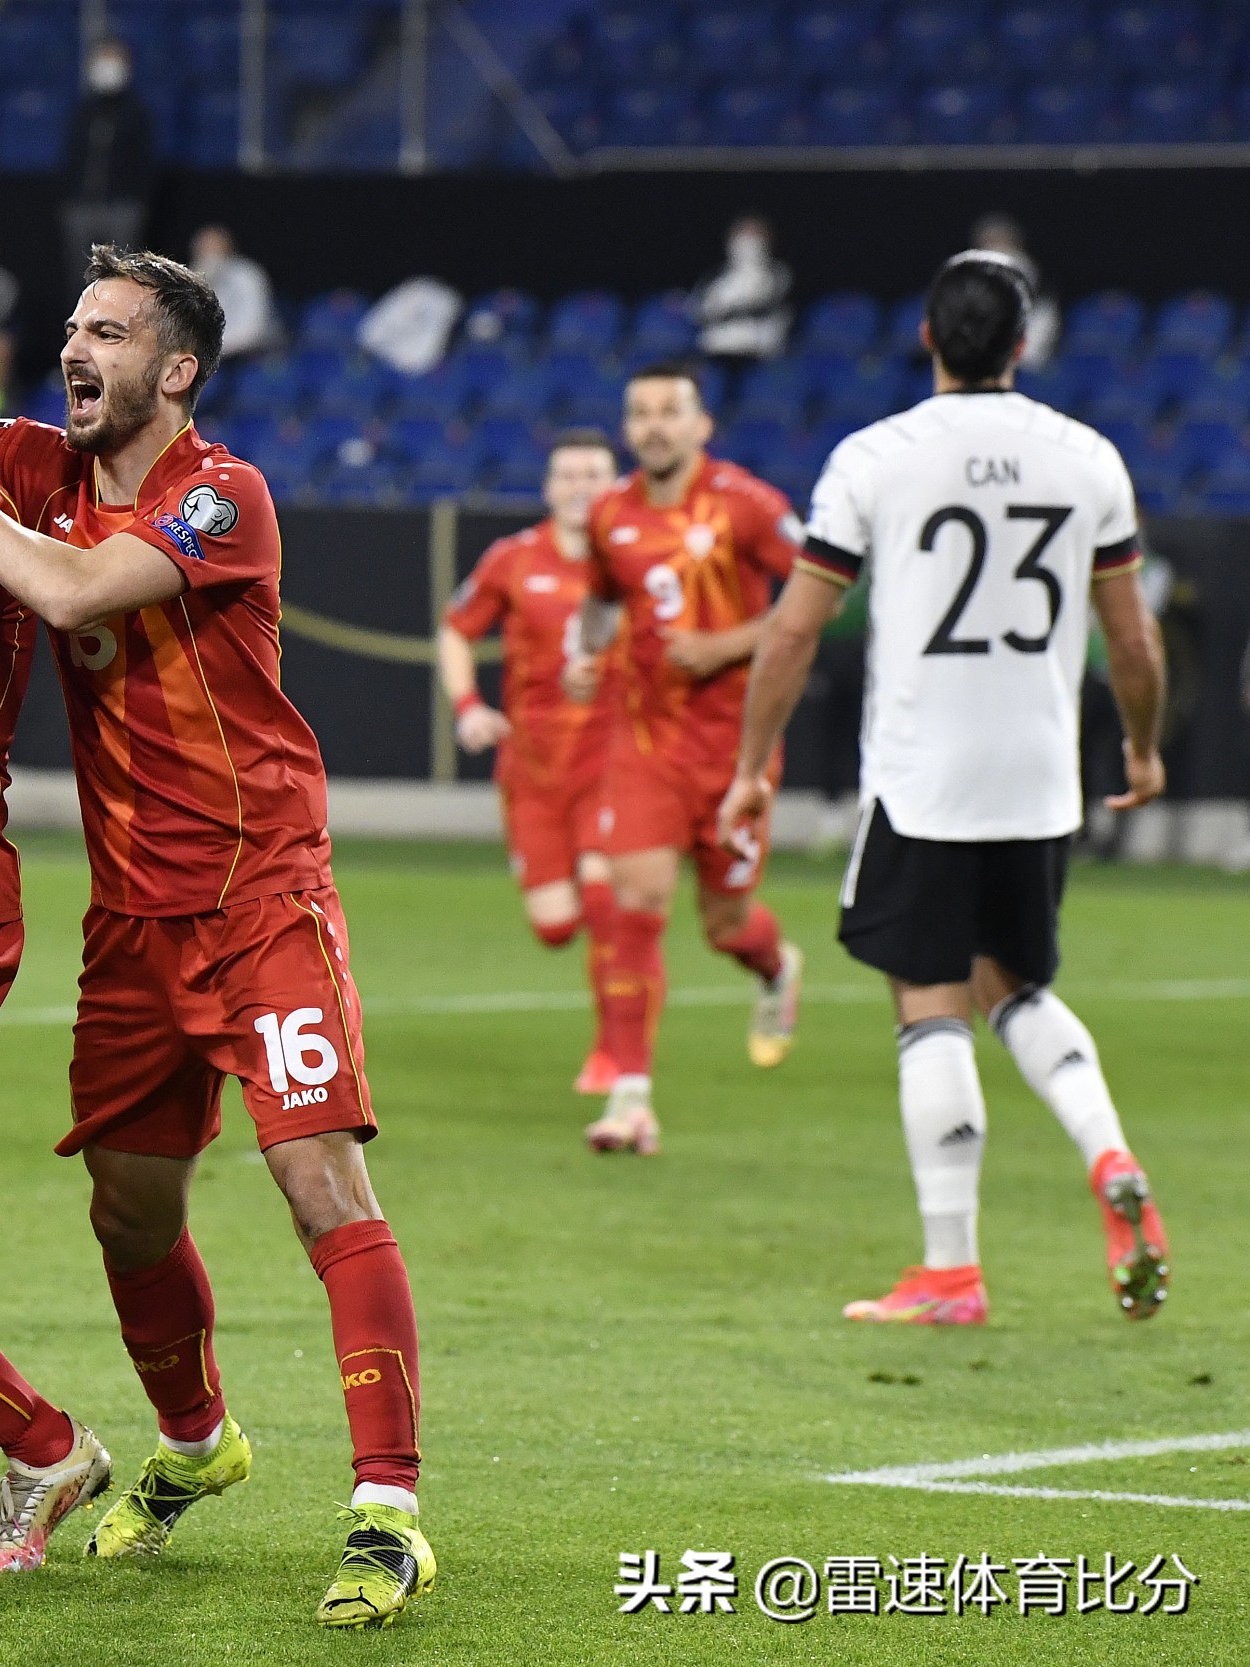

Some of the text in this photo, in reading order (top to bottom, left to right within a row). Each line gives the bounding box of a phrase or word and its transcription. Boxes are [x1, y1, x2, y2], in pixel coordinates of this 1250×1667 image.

[964, 456, 1021, 488] CAN
[53, 512, 74, 534] JA
[167, 521, 200, 560] RESPEC
[918, 503, 1075, 655] 23
[253, 1007, 339, 1093] 16
[281, 1086, 329, 1111] JAKO
